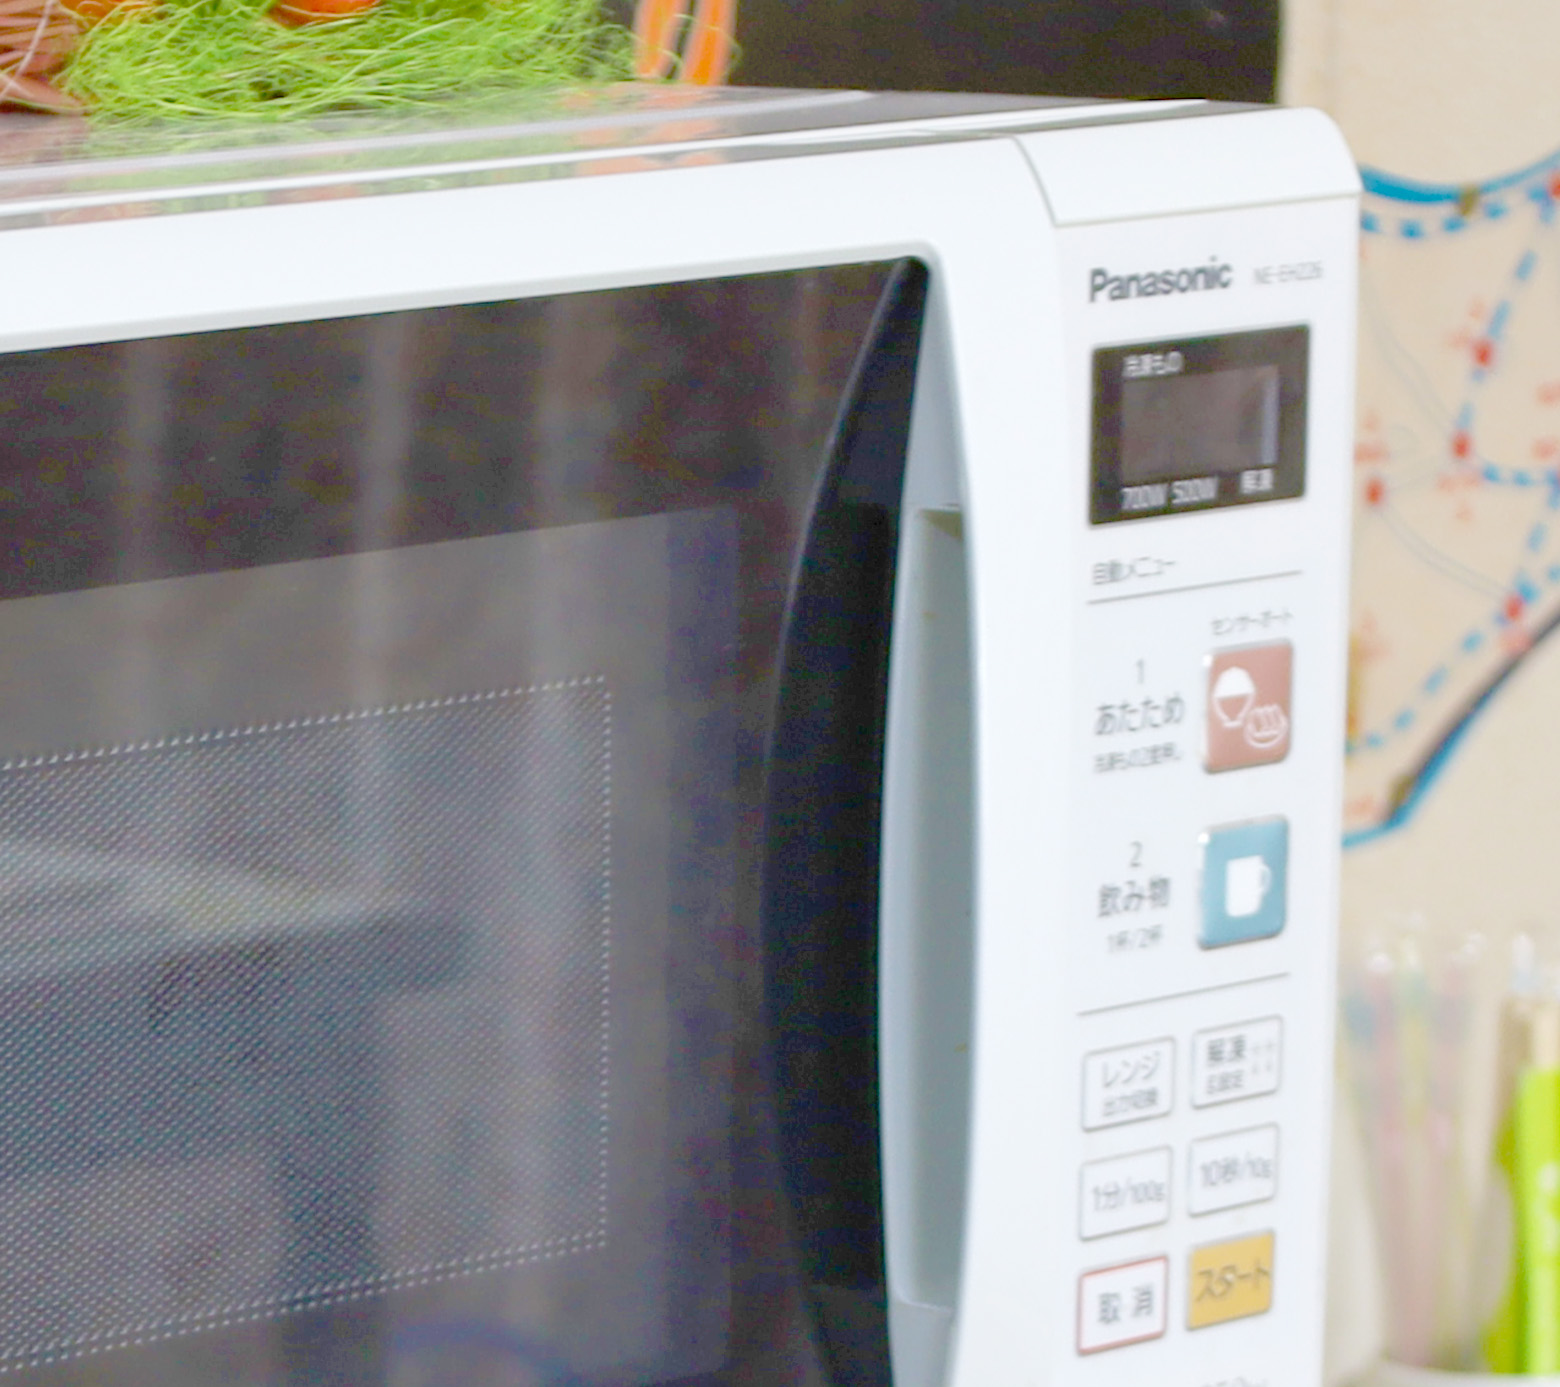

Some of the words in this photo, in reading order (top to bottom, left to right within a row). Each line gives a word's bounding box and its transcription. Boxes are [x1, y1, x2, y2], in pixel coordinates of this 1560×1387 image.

[1089, 256, 1233, 302] Panasonic
[1093, 696, 1185, 736] あたため
[1129, 841, 1143, 868] 2
[1097, 875, 1171, 918] 飲み物
[1101, 1051, 1161, 1089] レンジ
[1193, 1257, 1271, 1304] スタート
